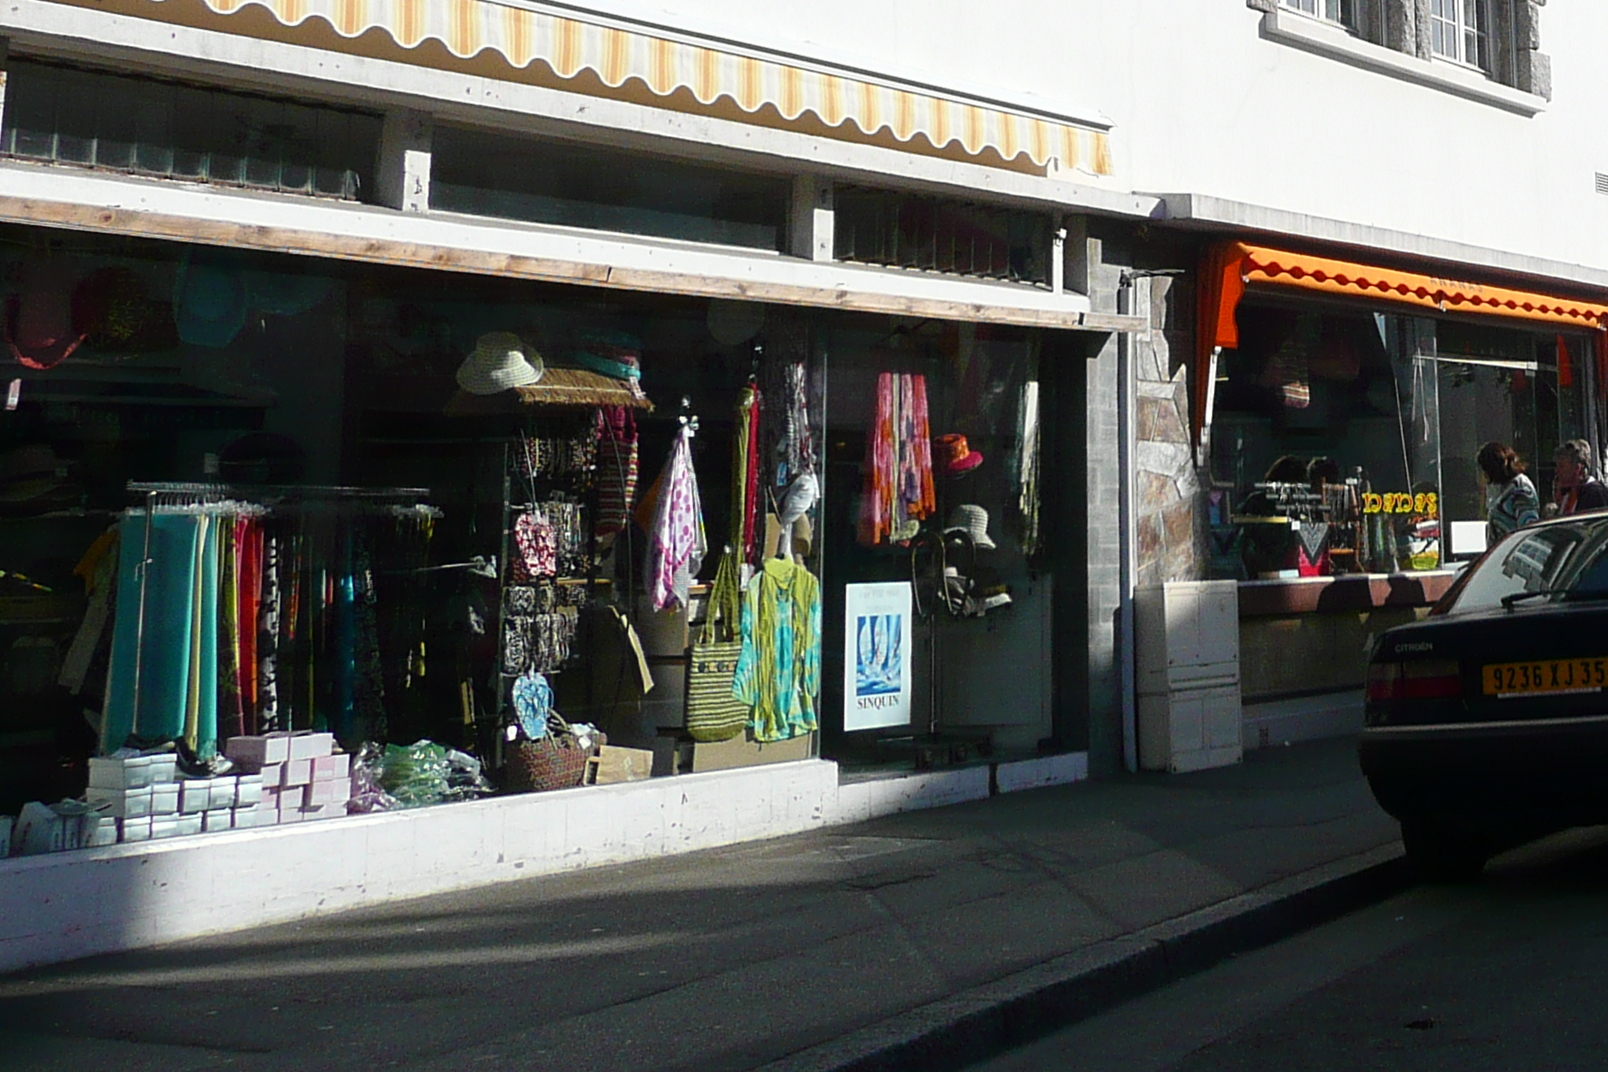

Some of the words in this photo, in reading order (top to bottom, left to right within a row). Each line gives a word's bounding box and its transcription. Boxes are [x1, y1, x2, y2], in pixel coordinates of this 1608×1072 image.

[1493, 665, 1542, 690] 9236
[1550, 663, 1573, 687] XJ
[1581, 661, 1606, 685] 35
[857, 695, 899, 710] SINQUIN
